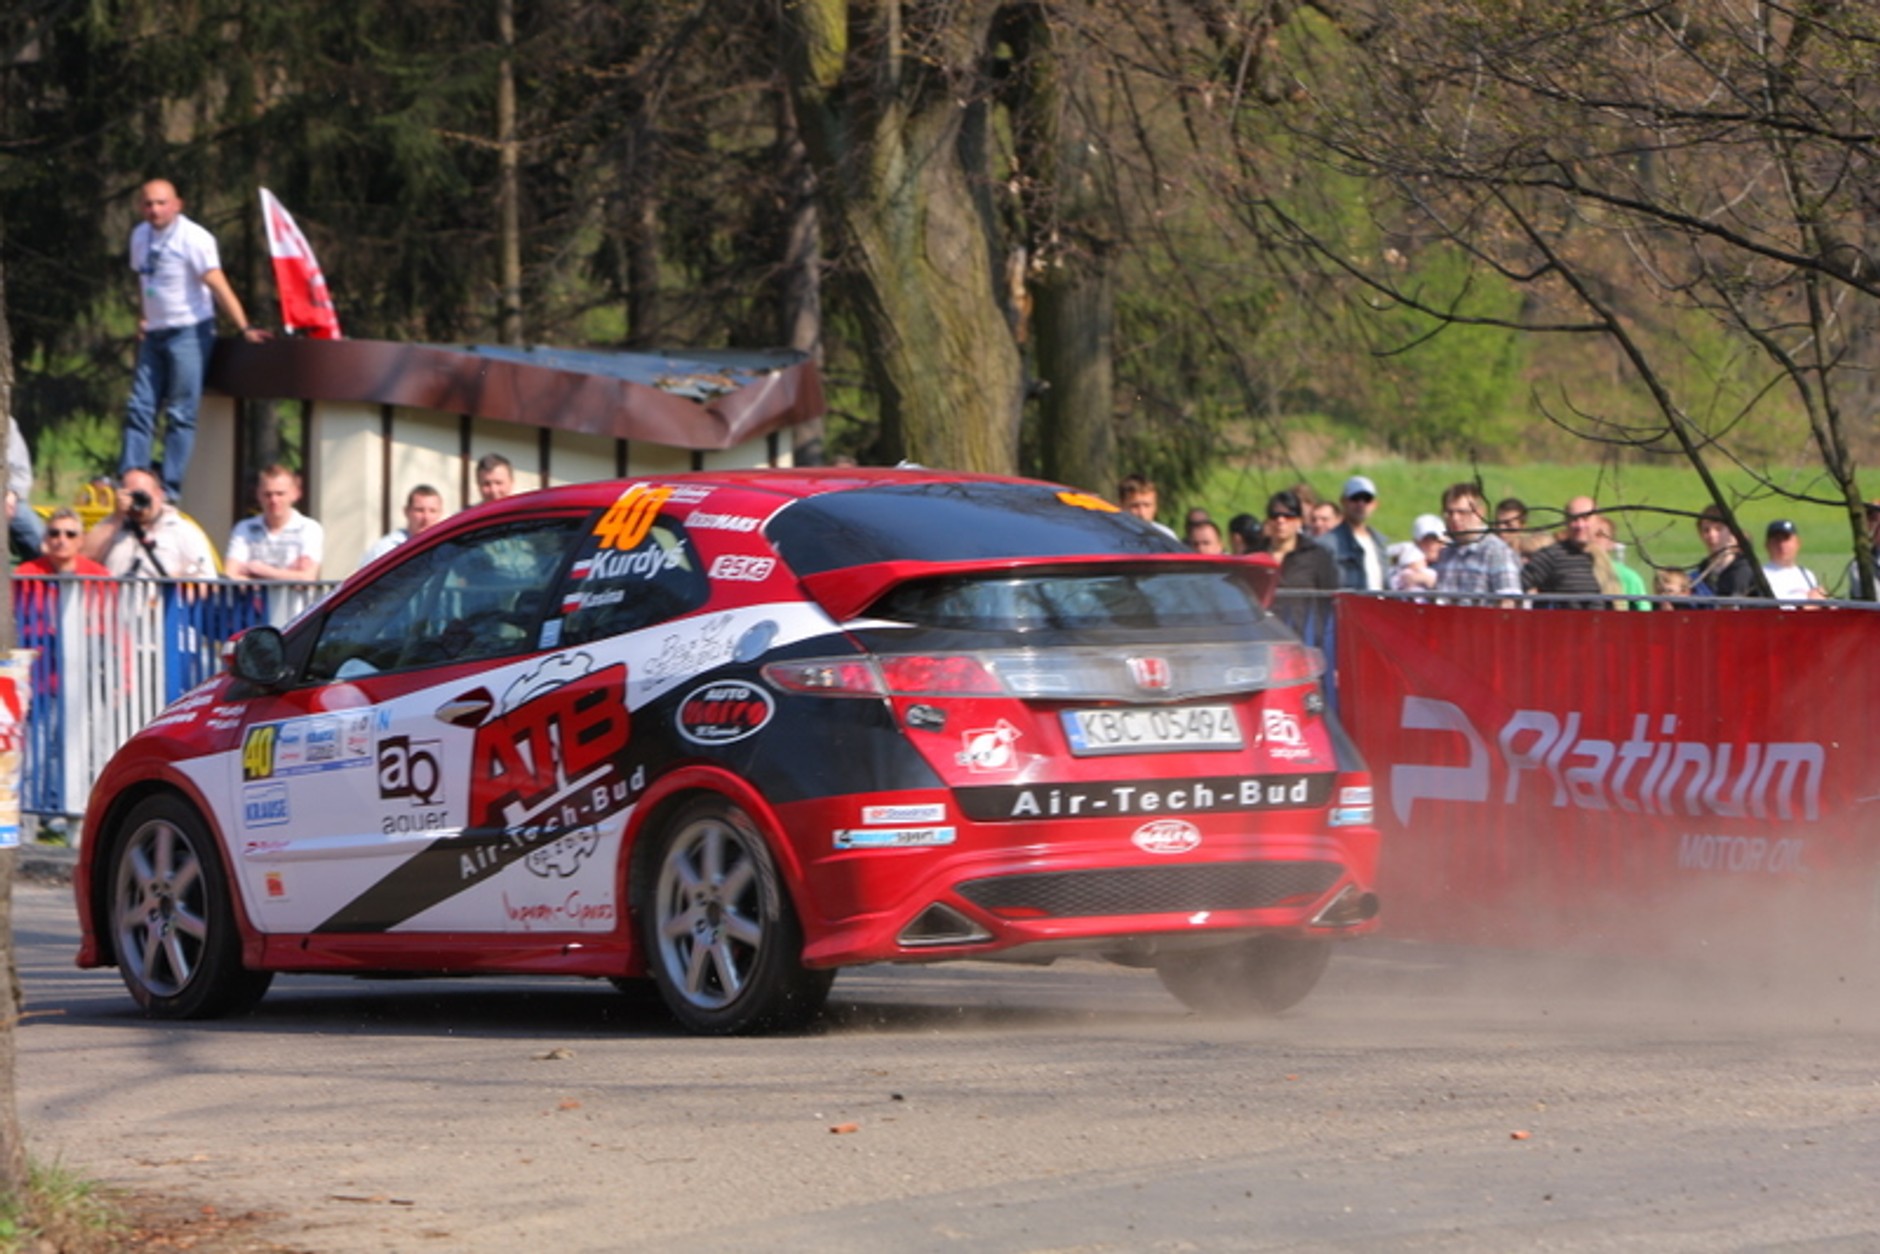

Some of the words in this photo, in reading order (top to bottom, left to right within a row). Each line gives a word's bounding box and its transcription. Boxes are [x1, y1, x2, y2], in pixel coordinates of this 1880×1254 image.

[592, 484, 676, 551] 40
[587, 538, 688, 580] Kurdyś
[705, 687, 750, 700] AUTO
[468, 662, 631, 829] ATB
[1084, 710, 1142, 744] KBC
[1150, 708, 1236, 741] 05494
[243, 725, 276, 777] 40
[1499, 709, 1825, 821] Platinum
[1010, 778, 1309, 817] Air-Tech-Bud
[1679, 833, 1767, 872] MOTOR
